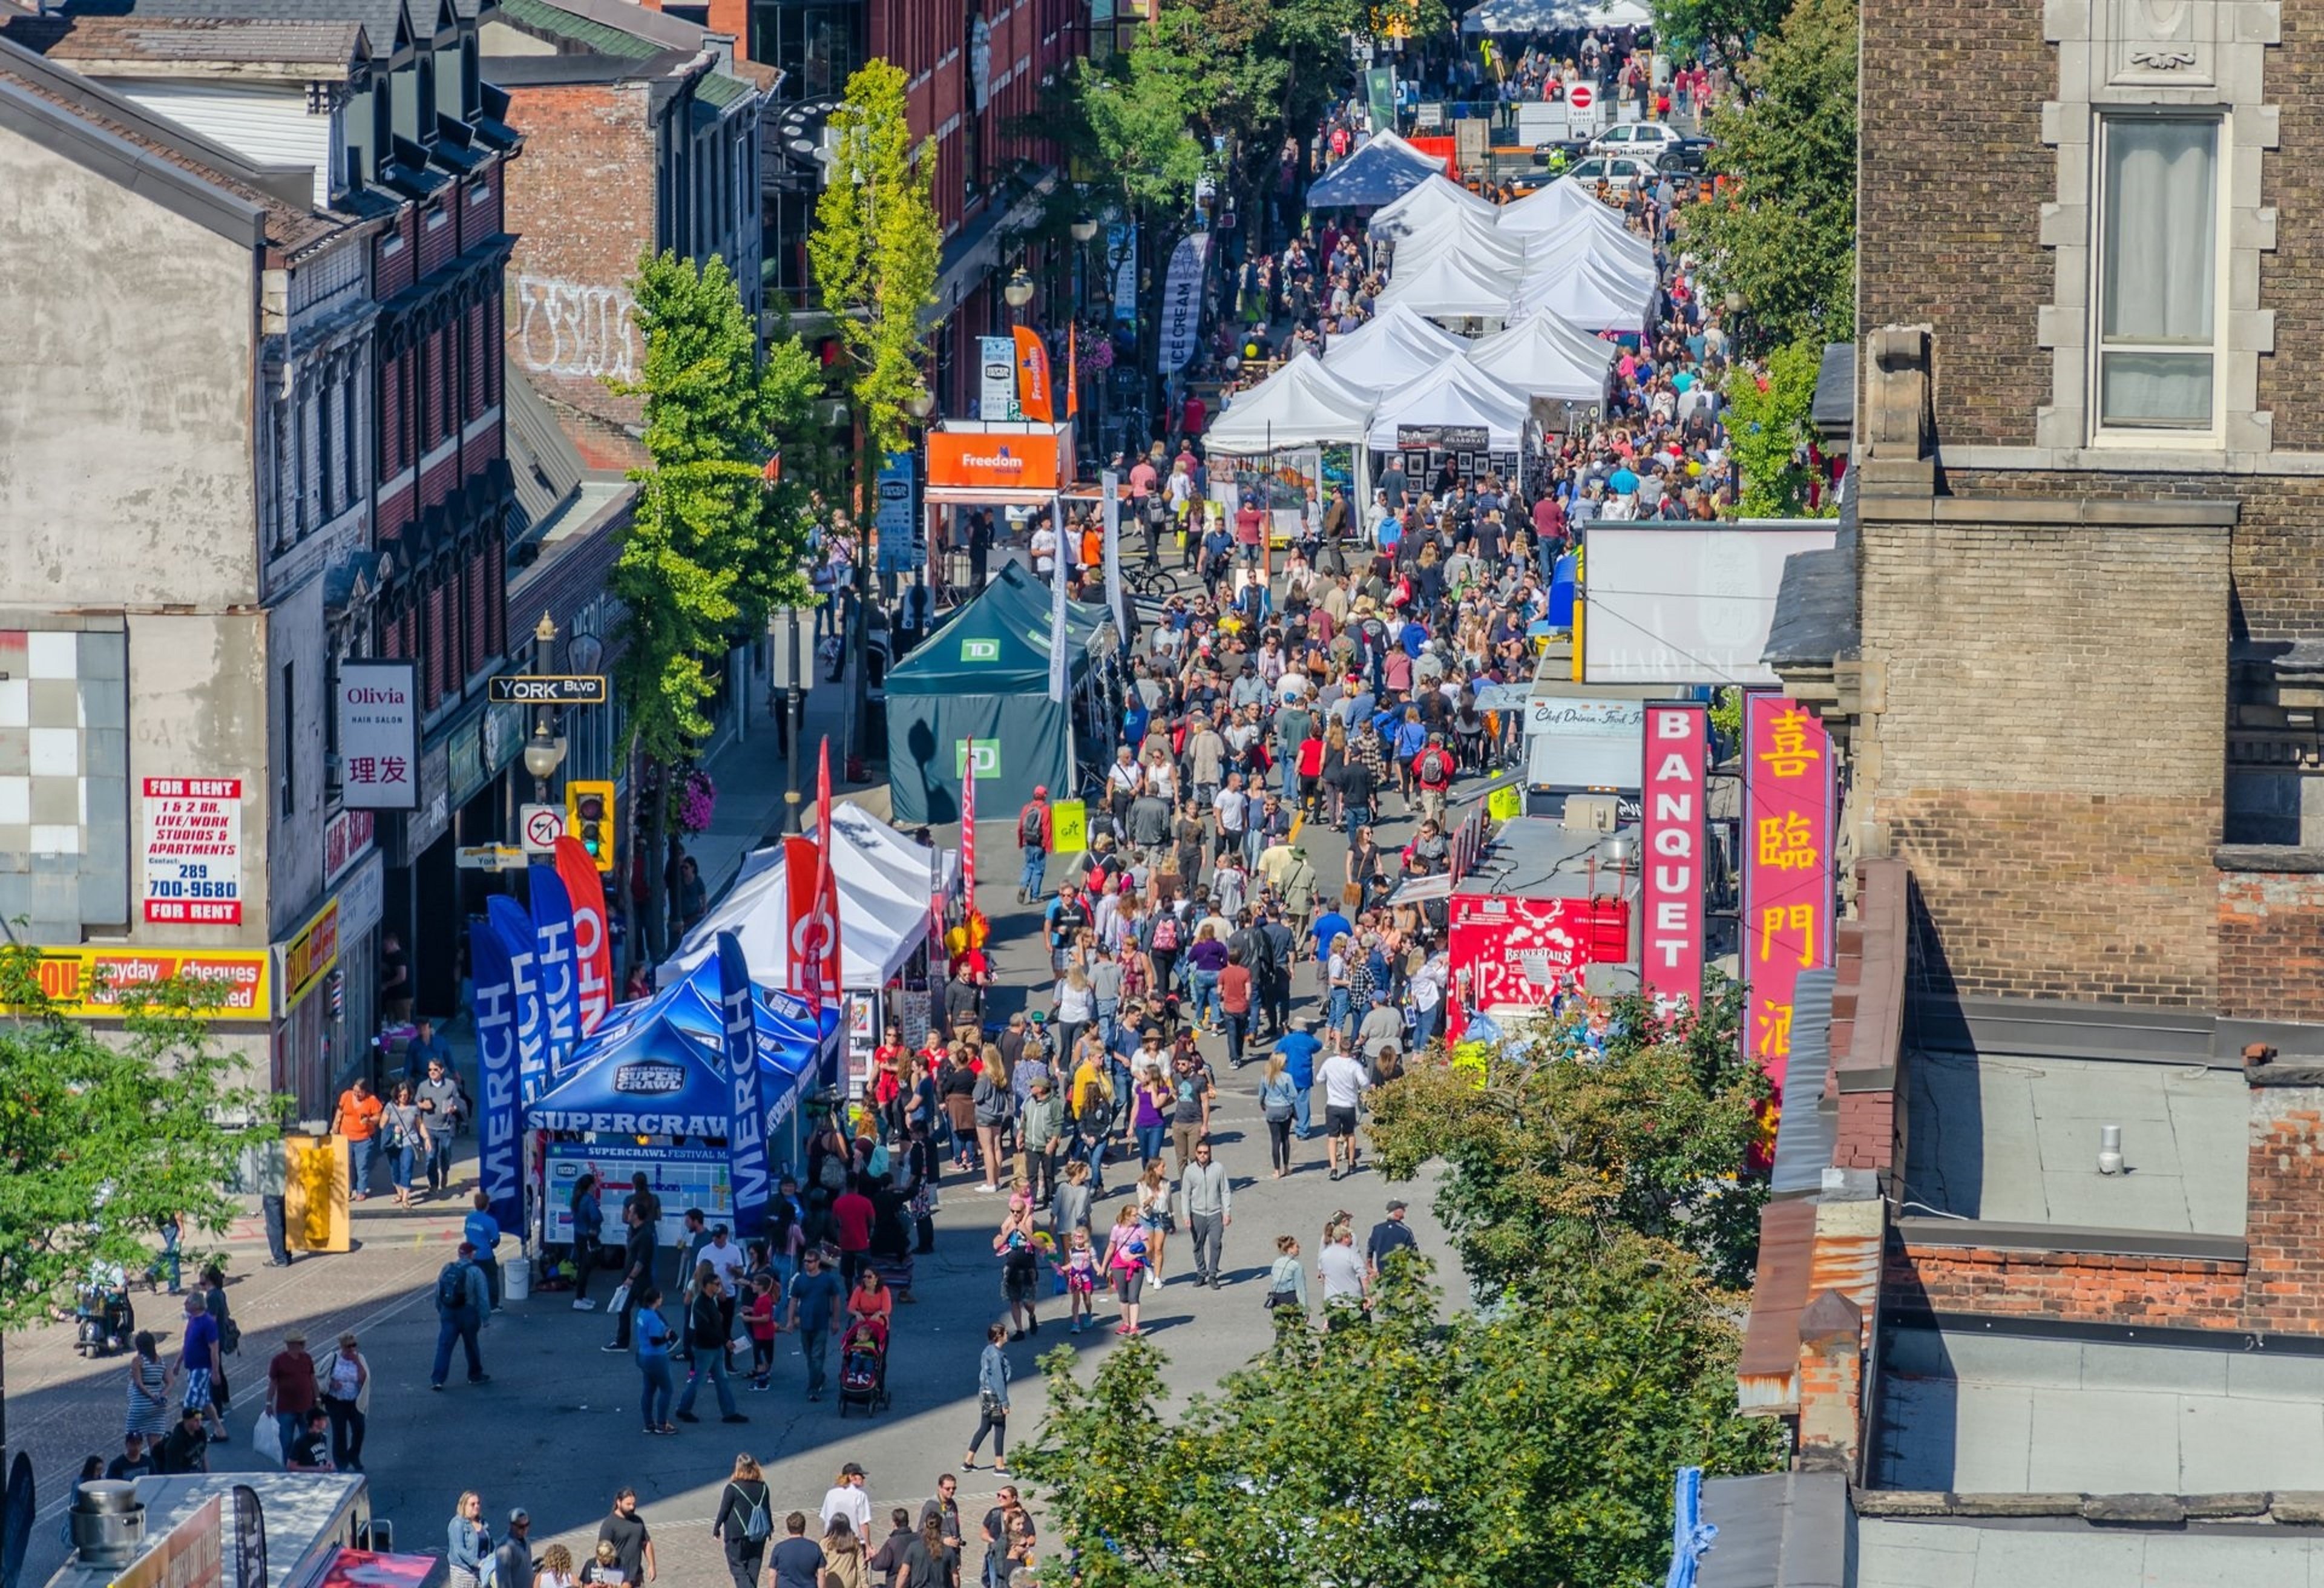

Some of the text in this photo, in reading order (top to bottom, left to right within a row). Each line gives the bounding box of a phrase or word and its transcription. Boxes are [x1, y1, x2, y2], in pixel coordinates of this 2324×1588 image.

[1171, 283, 1191, 364] ICE CREAM
[1031, 347, 1043, 400] Freedom
[1009, 402, 1018, 413] P
[962, 454, 1022, 467] Freedom
[965, 642, 996, 657] TD
[347, 687, 405, 704] Olivia
[499, 680, 596, 698] YORK BLVD
[349, 756, 407, 784] 理发
[151, 780, 234, 796] FOR RENT
[162, 802, 220, 813] 1 & 2 BR.
[155, 815, 229, 828] LIVE/WORK
[156, 829, 228, 841] STUDIOS &
[1656, 711, 1693, 967] BANQUET
[148, 843, 236, 856] APARTMENTS
[179, 864, 208, 879] 289
[149, 880, 237, 898] 700-9680
[151, 904, 234, 919] FOR RENT
[97, 959, 159, 983] payday
[181, 961, 256, 983] cheques
[573, 907, 606, 1040] NFO
[538, 920, 573, 1077] ERCH
[510, 951, 546, 1111] ERCH
[617, 1071, 682, 1081] SUPER
[477, 982, 516, 1203] MERCH
[617, 1081, 681, 1091] CRAWL
[724, 987, 769, 1209] MERCH
[528, 1110, 727, 1137] SUPERCRAW
[588, 1147, 666, 1158] SUPERCRAWL
[668, 1150, 715, 1160] FESTIVAL
